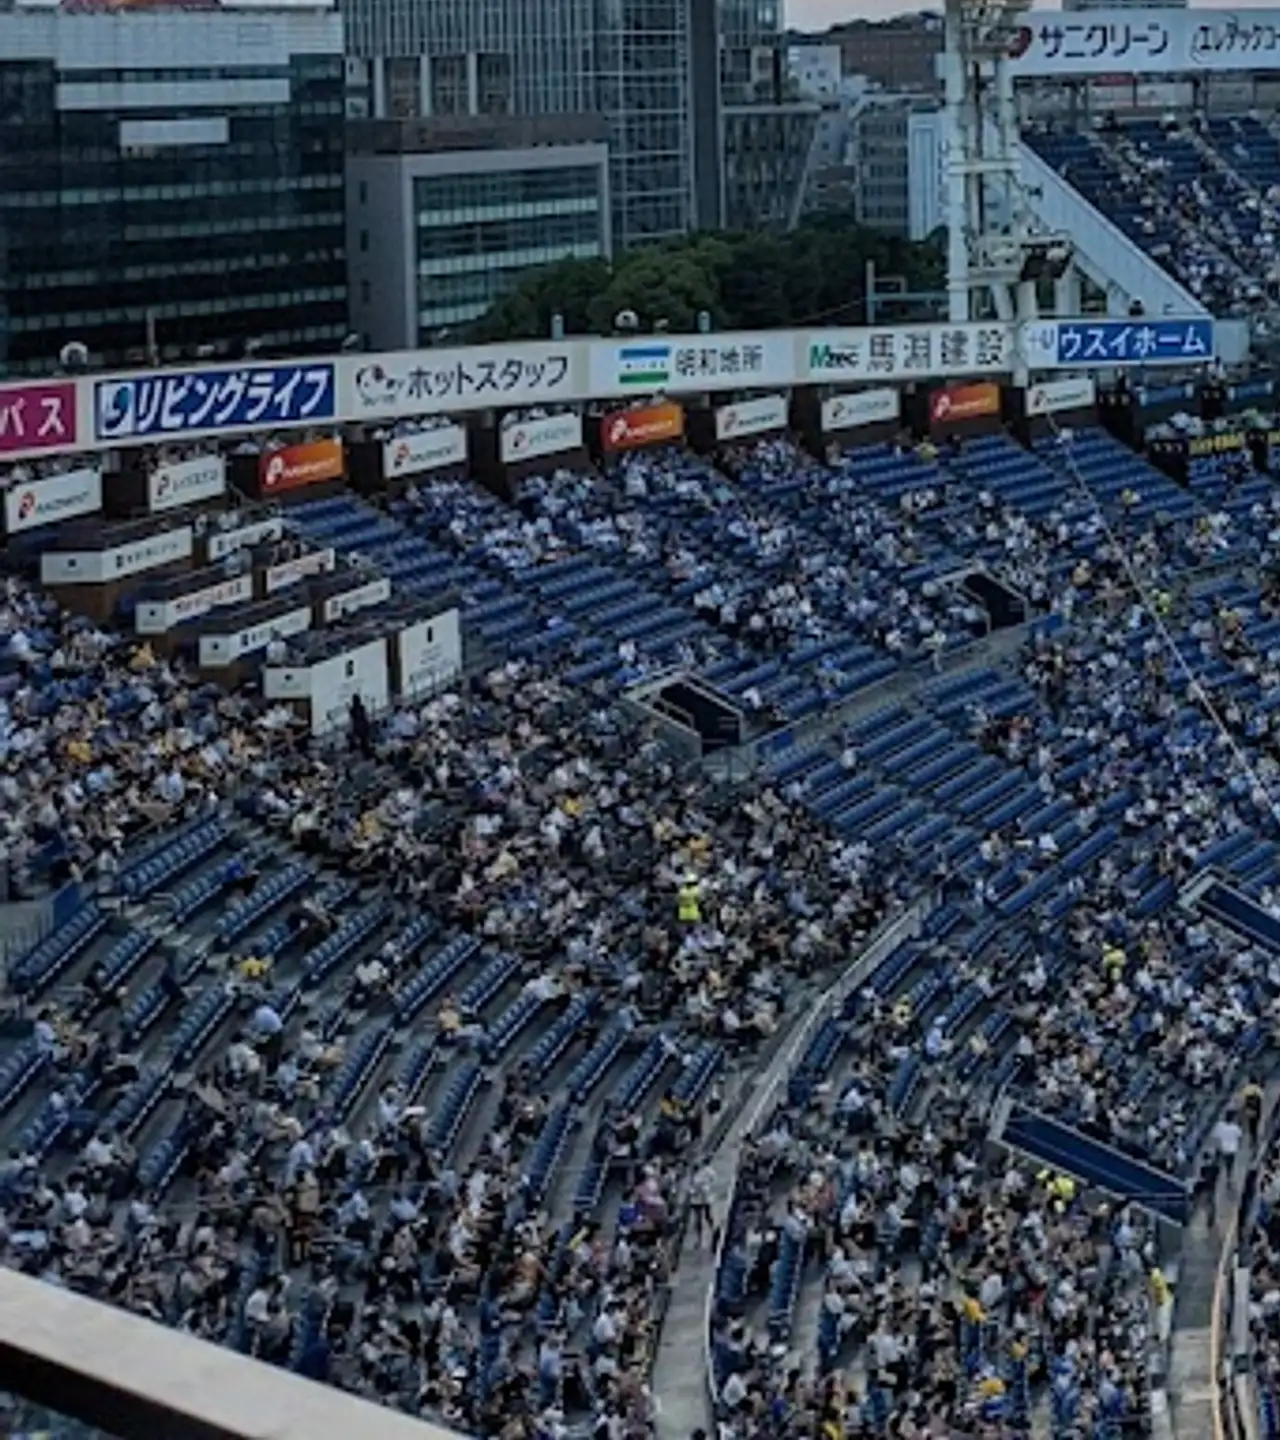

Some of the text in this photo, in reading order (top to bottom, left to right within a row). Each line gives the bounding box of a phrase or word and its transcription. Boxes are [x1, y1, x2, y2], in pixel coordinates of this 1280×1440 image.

[1039, 24, 1168, 58] サニクリーン
[1060, 325, 1206, 359] ウスイホーム
[407, 356, 569, 399] ホットスタッフ
[137, 368, 331, 429] リビングライフ
